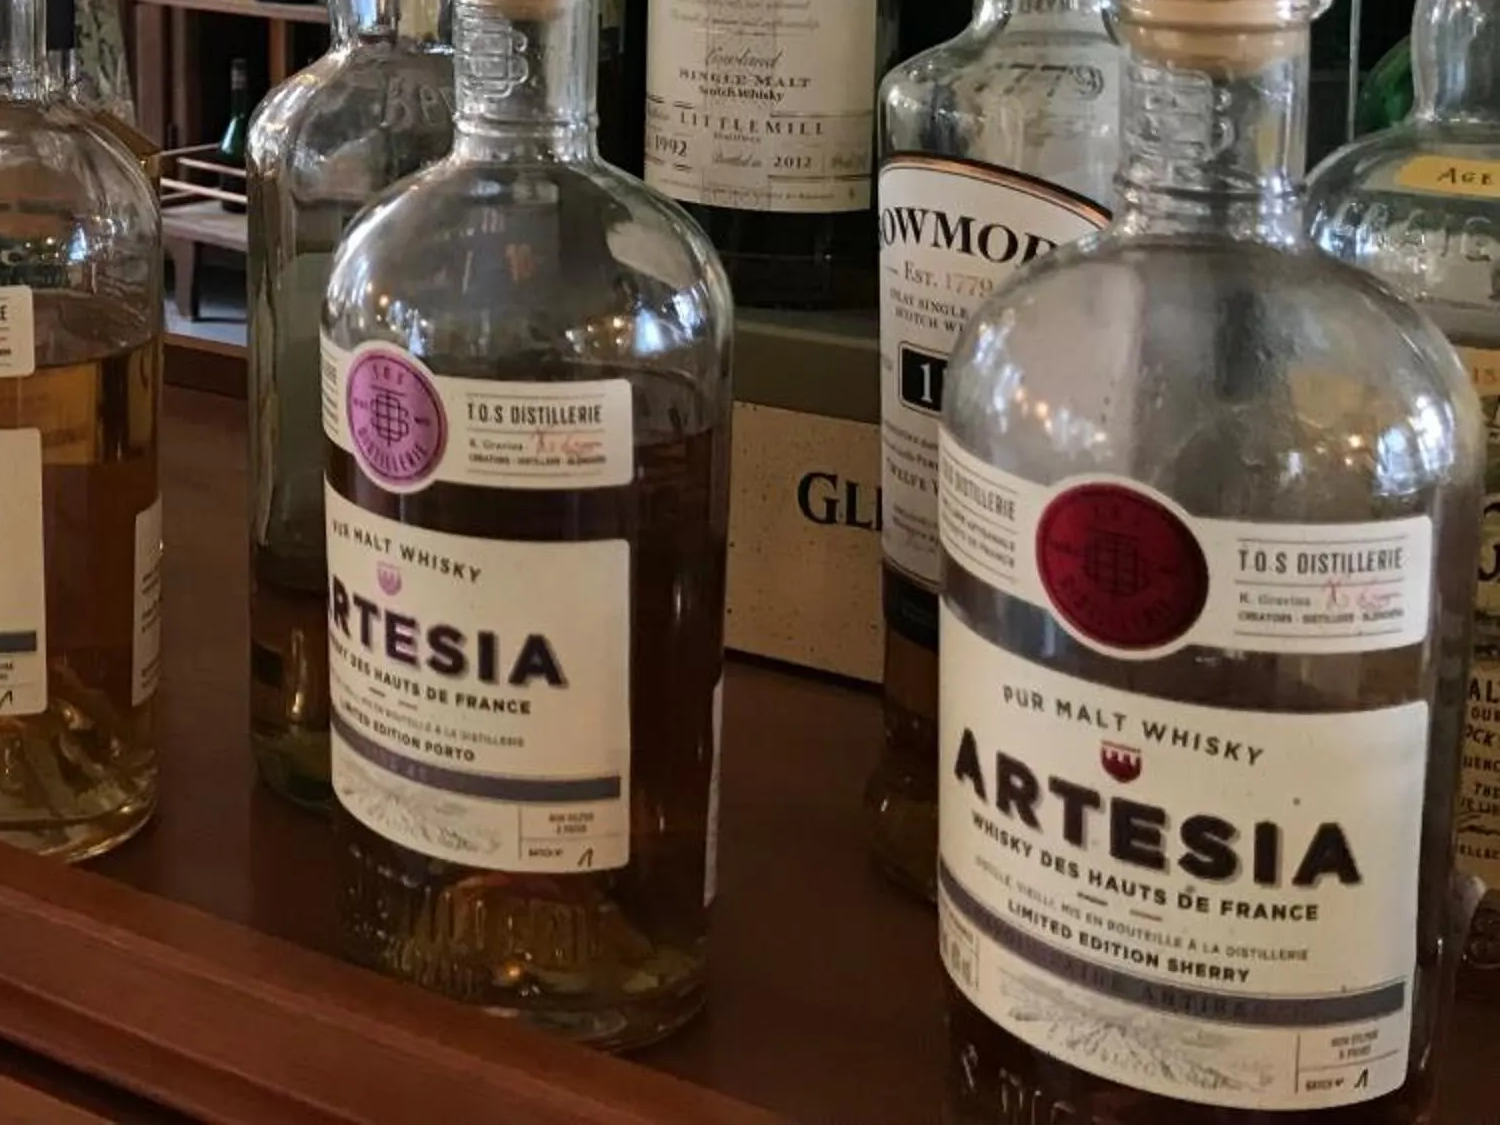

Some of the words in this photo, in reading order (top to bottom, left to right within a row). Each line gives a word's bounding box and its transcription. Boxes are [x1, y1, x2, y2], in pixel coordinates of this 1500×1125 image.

[754, 76, 812, 88] MALT
[879, 206, 1060, 269] OWMOR
[919, 362, 933, 403] 1
[510, 404, 603, 426] DISTILLERIE
[353, 528, 393, 555] MALT
[400, 544, 483, 584] WHISKY
[1296, 547, 1404, 576] DISTILLERIE
[329, 573, 570, 689] RTESIA
[374, 667, 421, 698] HAUTS
[426, 686, 449, 705] DE
[454, 692, 532, 716] FRANCE
[373, 722, 421, 751] EDITION
[425, 740, 476, 763] PORTO
[1002, 684, 1045, 713] PUR
[1055, 697, 1128, 733] MALT
[1141, 720, 1266, 768] WHISKY
[953, 725, 1365, 889] ARTESIA
[971, 809, 1034, 859] WHISKY
[1040, 849, 1081, 880] DES
[1087, 868, 1167, 906] HAUTS
[1177, 891, 1211, 913] DE
[1219, 899, 1320, 923] FRANCE
[1007, 897, 1074, 942] LIMITED
[1078, 930, 1161, 969] EDITION
[1166, 957, 1251, 985] SHERRY
[1106, 921, 1184, 950] BOUTEILLE
[1202, 941, 1221, 956] LA
[1225, 944, 1311, 963] DISTILLERIE
